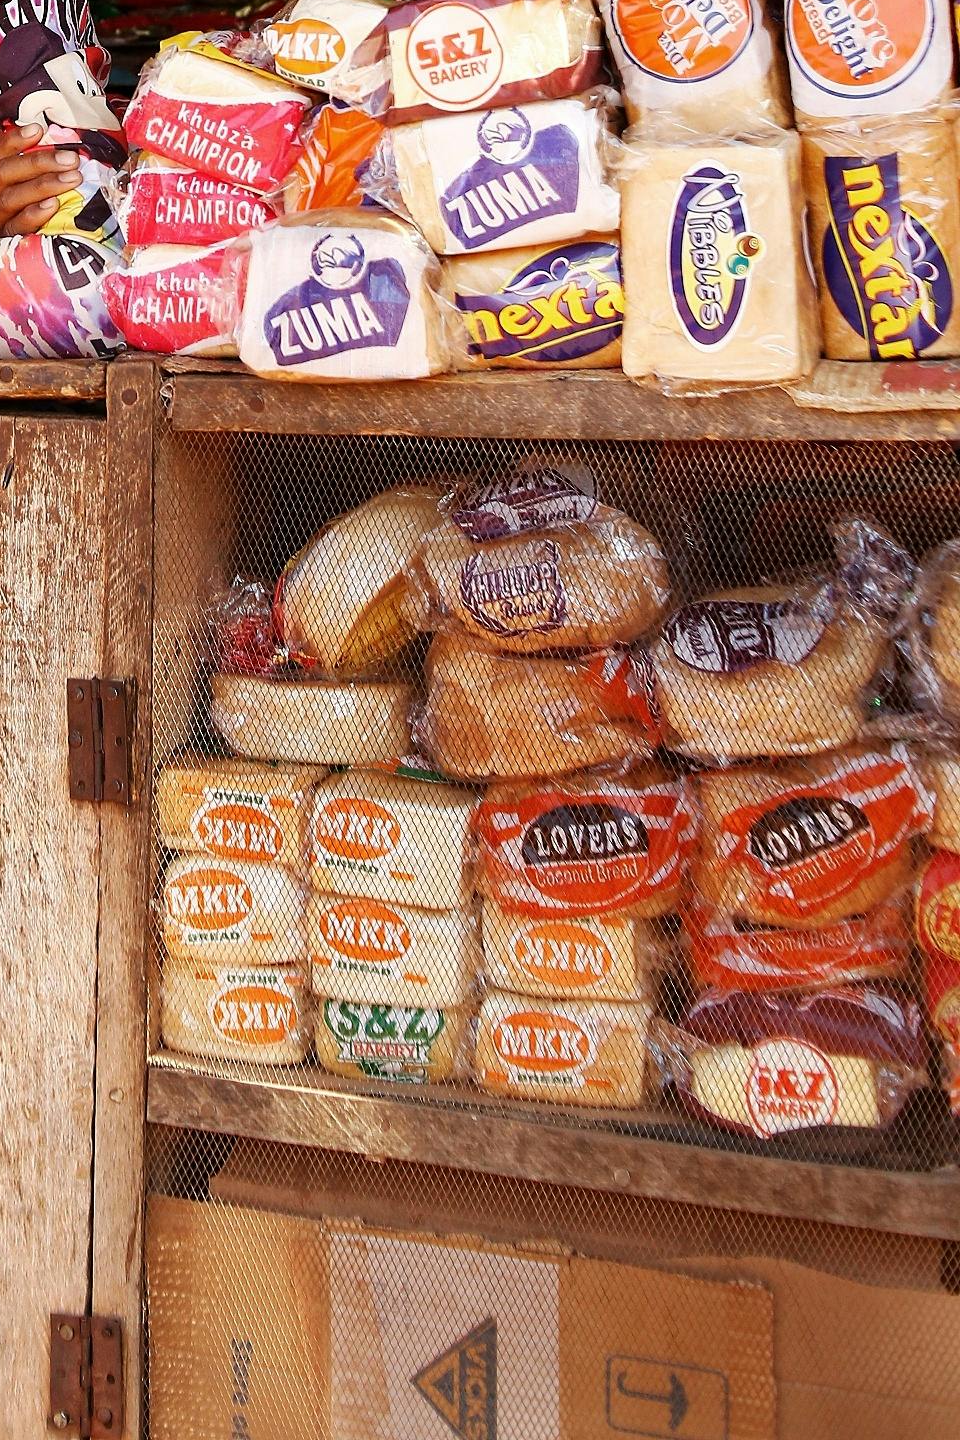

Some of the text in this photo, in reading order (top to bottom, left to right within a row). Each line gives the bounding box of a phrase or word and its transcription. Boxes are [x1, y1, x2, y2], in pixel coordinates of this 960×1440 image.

[265, 26, 342, 63] MKK
[415, 27, 492, 70] S&Z
[657, 31, 686, 68] Diva
[429, 59, 490, 85] BAKERY
[178, 103, 258, 151] khubza
[145, 116, 263, 184] CHAMPION
[155, 196, 267, 228] CHAMPION
[445, 163, 561, 240] ZUMA
[270, 291, 385, 358] ZUMA
[202, 816, 278, 855] MKK
[317, 811, 394, 849] MKK
[533, 816, 639, 859] LOVERS
[168, 884, 250, 916] MKK
[325, 910, 408, 954] MKK
[522, 936, 605, 977] MKK
[216, 1000, 294, 1029] MKK
[499, 1023, 588, 1062] MKK
